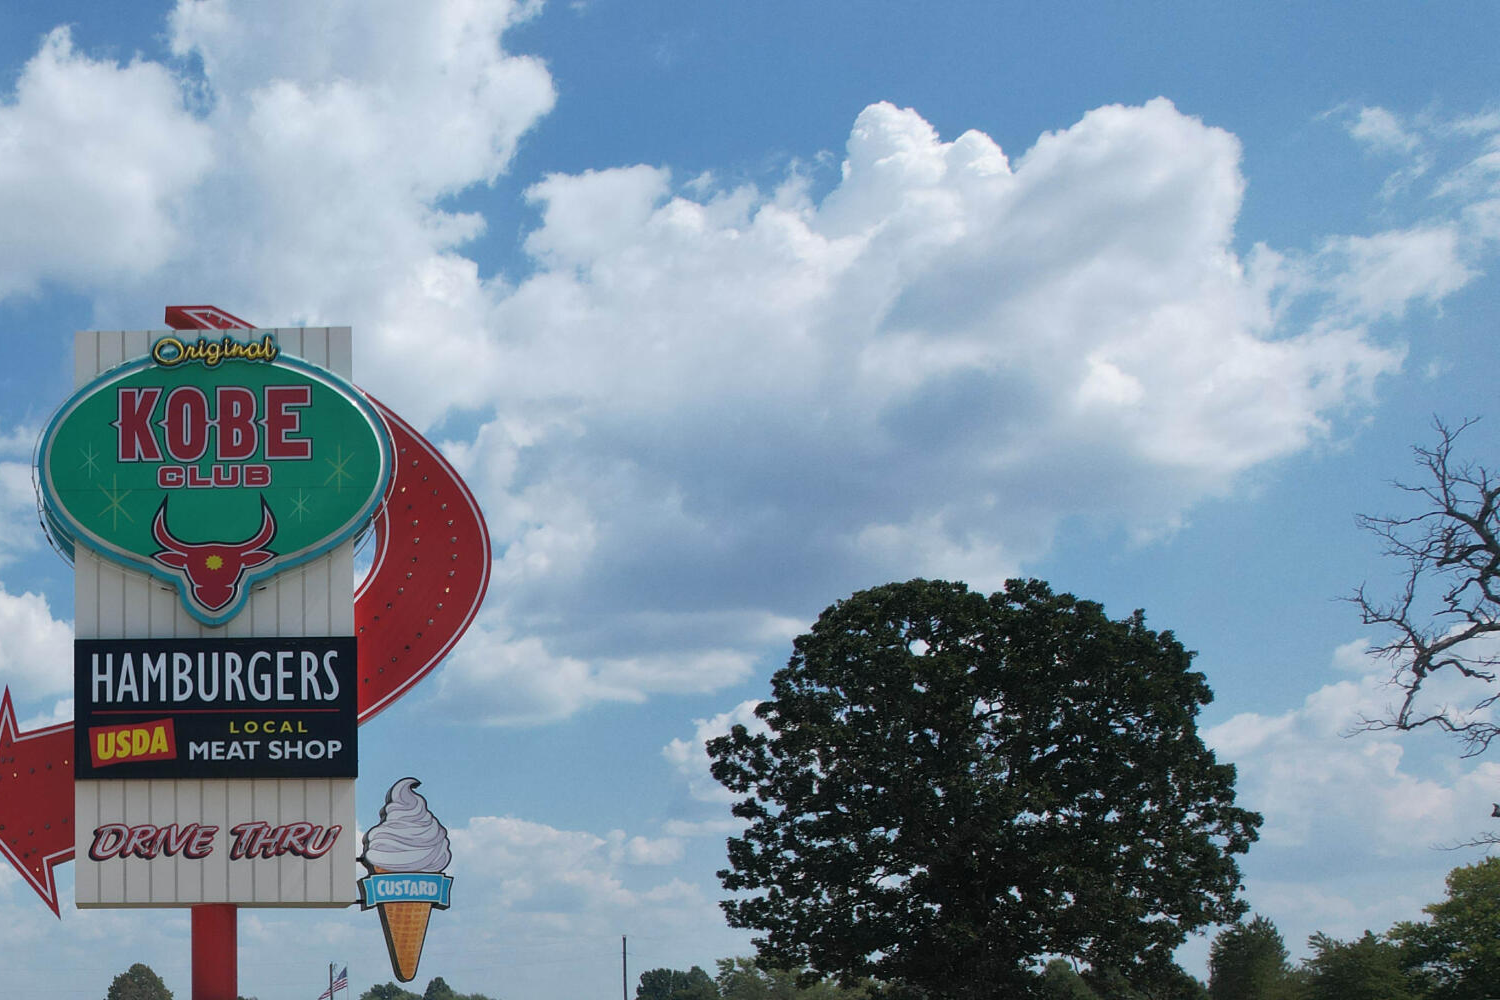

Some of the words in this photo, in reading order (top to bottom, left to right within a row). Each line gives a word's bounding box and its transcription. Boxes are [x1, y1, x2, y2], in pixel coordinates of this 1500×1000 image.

[153, 335, 278, 366] Original
[109, 385, 313, 463] KOBE
[157, 465, 272, 489] CLUB
[91, 650, 341, 703] HAMBURGERS
[229, 720, 309, 734] LOCAL
[97, 726, 169, 760] USDA
[188, 741, 261, 761] MEAT
[268, 740, 343, 760] SHOP
[88, 823, 220, 862] DRIVE
[229, 821, 343, 861] THRU
[377, 879, 438, 897] CUSTARD
